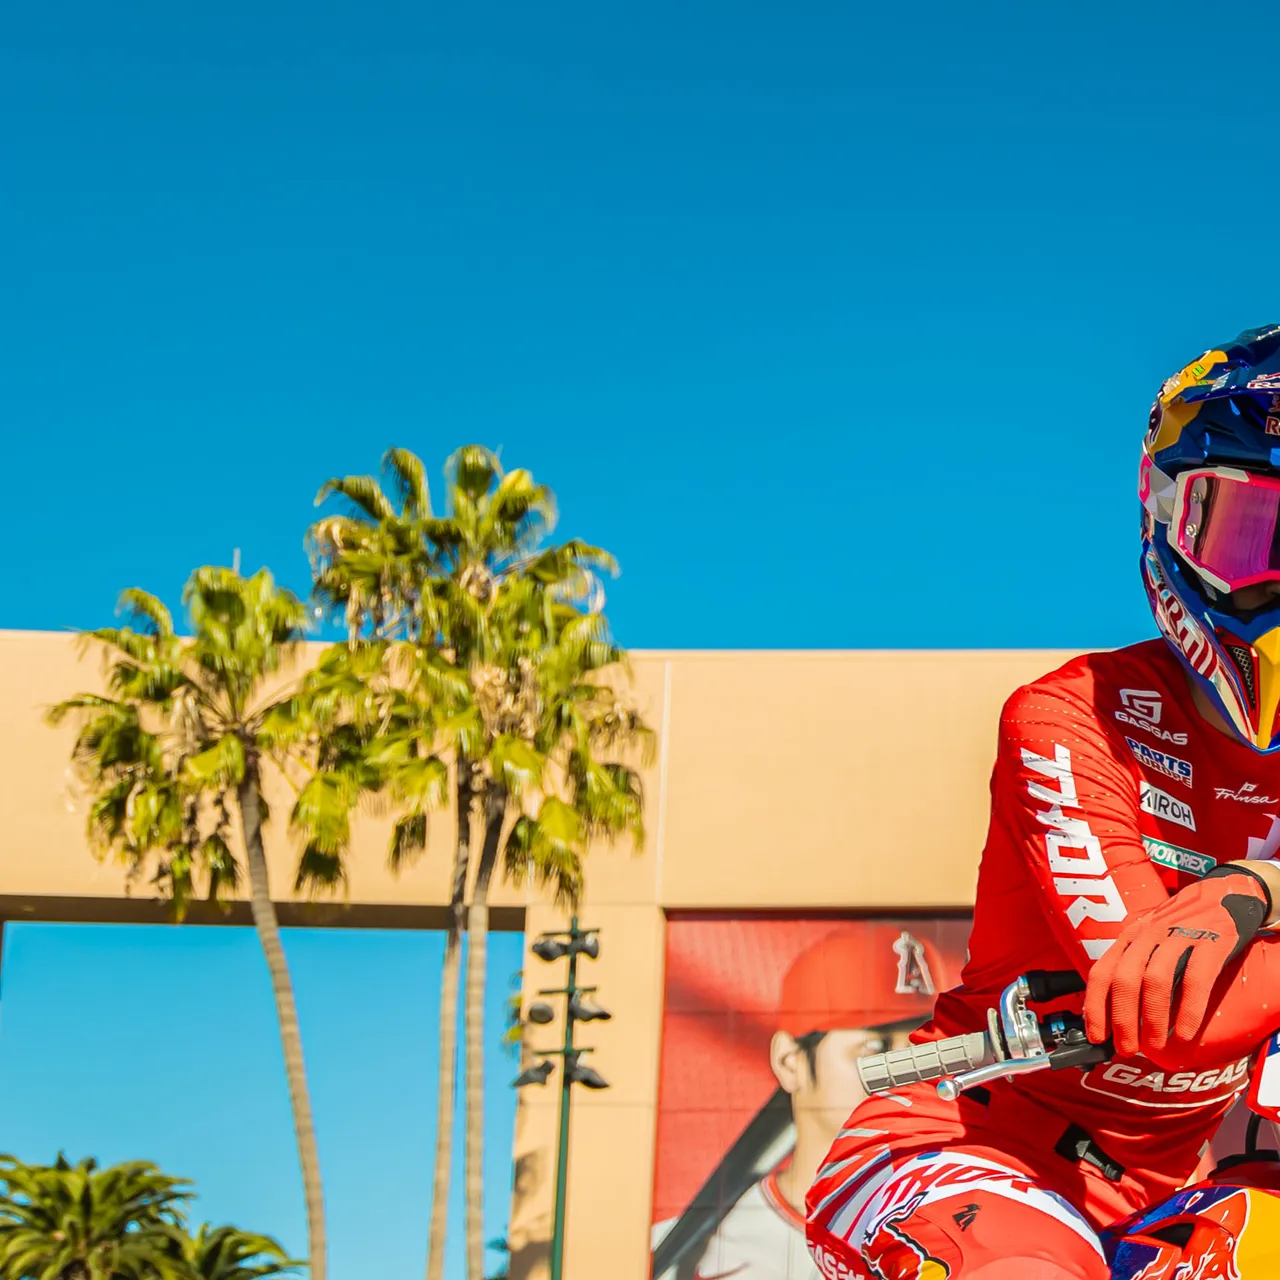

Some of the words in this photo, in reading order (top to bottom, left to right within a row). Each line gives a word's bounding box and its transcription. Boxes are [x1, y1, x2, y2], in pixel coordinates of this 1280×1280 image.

[1114, 711, 1188, 746] GASGAS
[1125, 736, 1192, 778] PARTS
[1141, 788, 1193, 827] AIROH
[1143, 839, 1211, 874] MOTOREX
[1167, 925, 1222, 944] THOR
[1101, 1054, 1249, 1095] GASGAS
